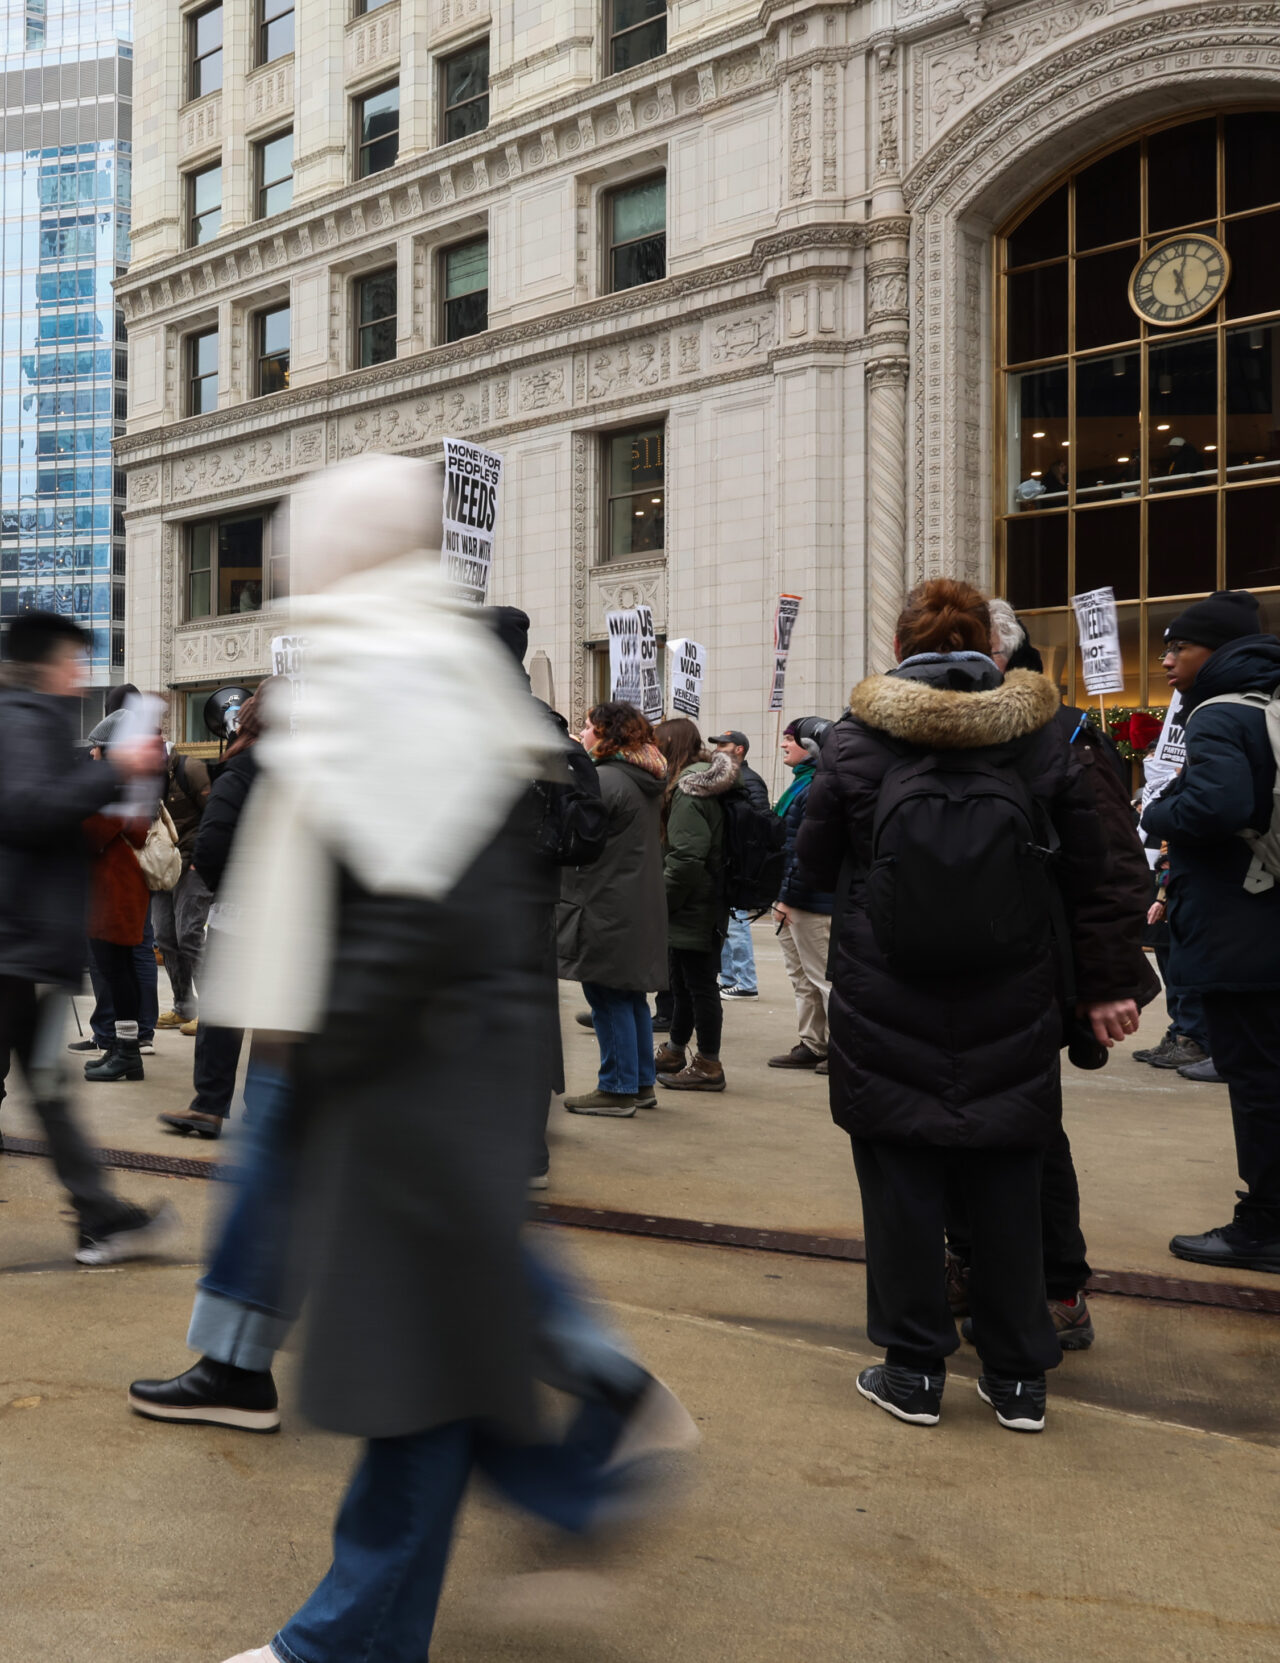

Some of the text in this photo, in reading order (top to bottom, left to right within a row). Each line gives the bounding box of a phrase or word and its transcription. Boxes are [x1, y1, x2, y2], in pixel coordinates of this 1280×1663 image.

[447, 443, 501, 471] MONEY FOR
[448, 456, 498, 485] PEOPLE'S
[446, 471, 497, 532] NEEDS
[446, 529, 491, 562] NOT WAR WITH
[637, 609, 654, 637] US
[641, 640, 656, 660] OUT
[685, 642, 697, 660] NO
[680, 657, 701, 678] WAR
[685, 678, 696, 693] ON
